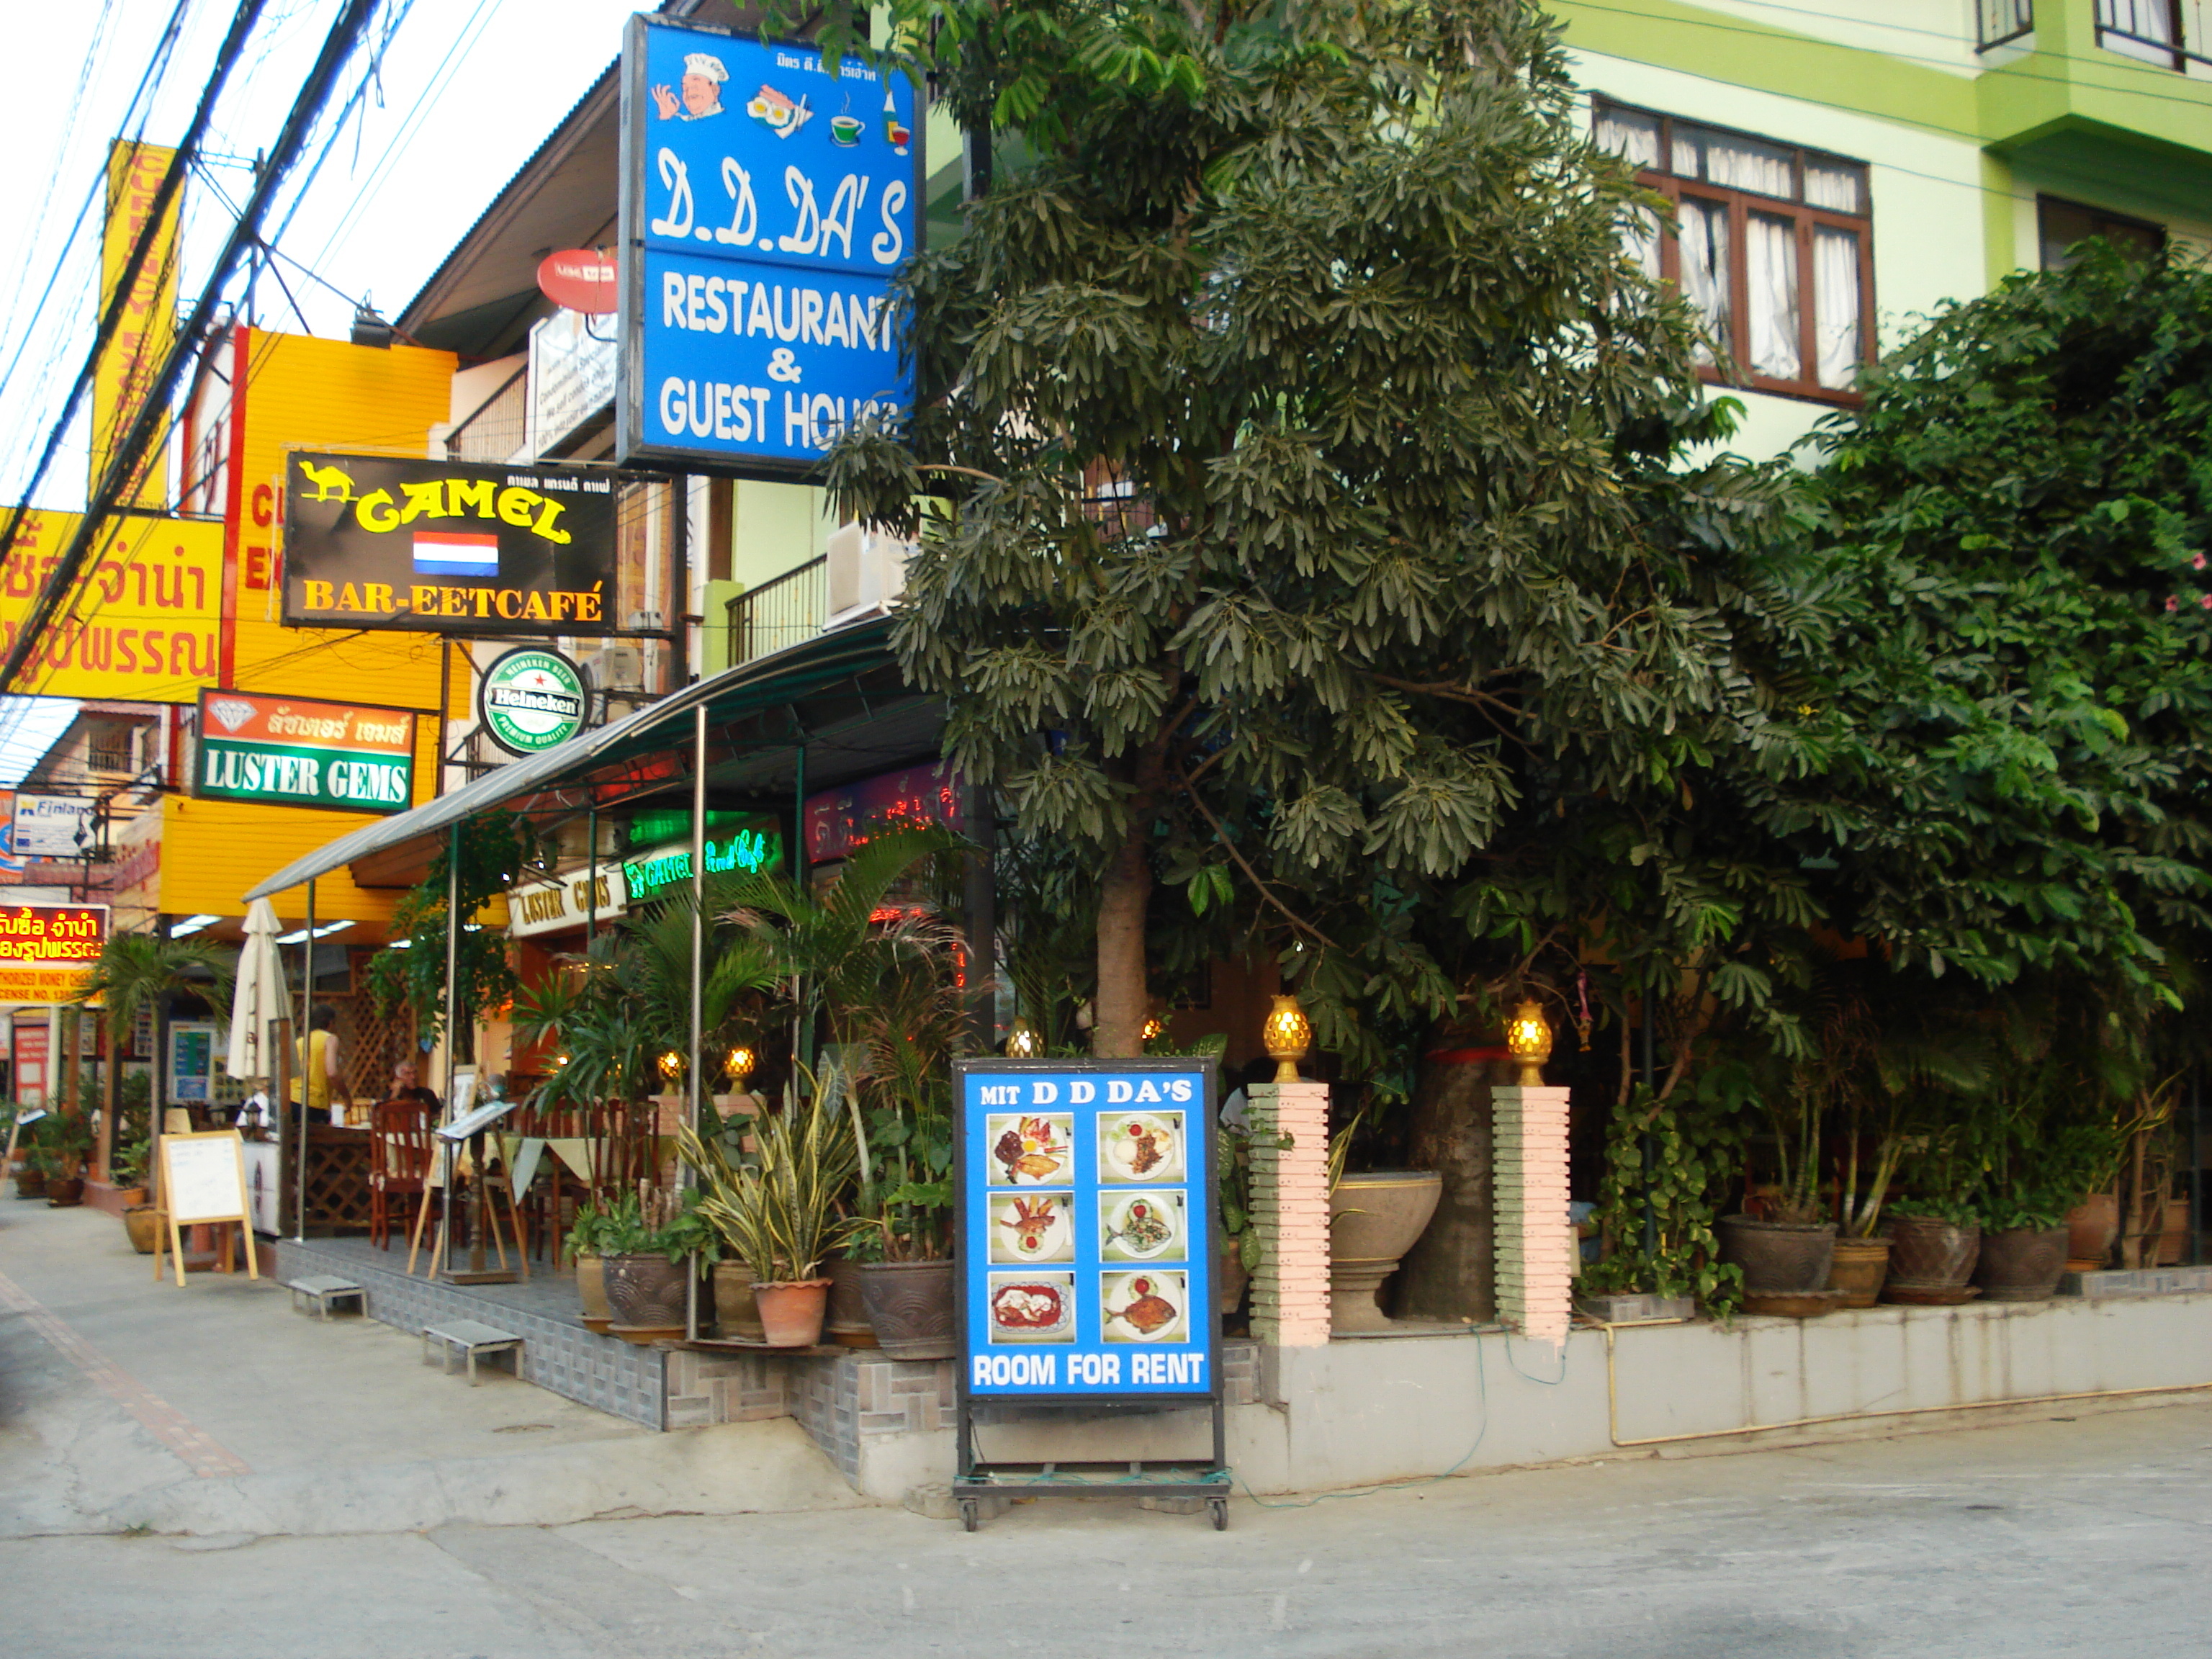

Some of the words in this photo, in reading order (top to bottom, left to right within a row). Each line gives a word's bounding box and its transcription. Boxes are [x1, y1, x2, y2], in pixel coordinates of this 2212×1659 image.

[662, 271, 897, 352] RESTAURANT
[767, 347, 802, 385] &
[660, 376, 770, 443] GUEST
[356, 478, 572, 545] CAMEL
[303, 580, 603, 622] BAR-EETCAFÉ
[505, 658, 550, 676] HEINEKEN
[552, 663, 572, 685] BEER
[495, 688, 577, 715] Heineken
[498, 715, 533, 745] PREMIUM
[535, 723, 568, 745] QUALITY
[204, 749, 320, 796] LUSTER
[327, 760, 408, 804] GEMS
[644, 853, 695, 887] CAMEL
[518, 889, 567, 925] LUSTER
[980, 1086, 1021, 1105] MIT
[1031, 1082, 1059, 1105] D
[1069, 1081, 1096, 1105] D
[1107, 1079, 1192, 1104] DA'S
[973, 1354, 1056, 1386] ROOM
[1067, 1353, 1121, 1385] FOR
[1131, 1353, 1205, 1384] RENT
